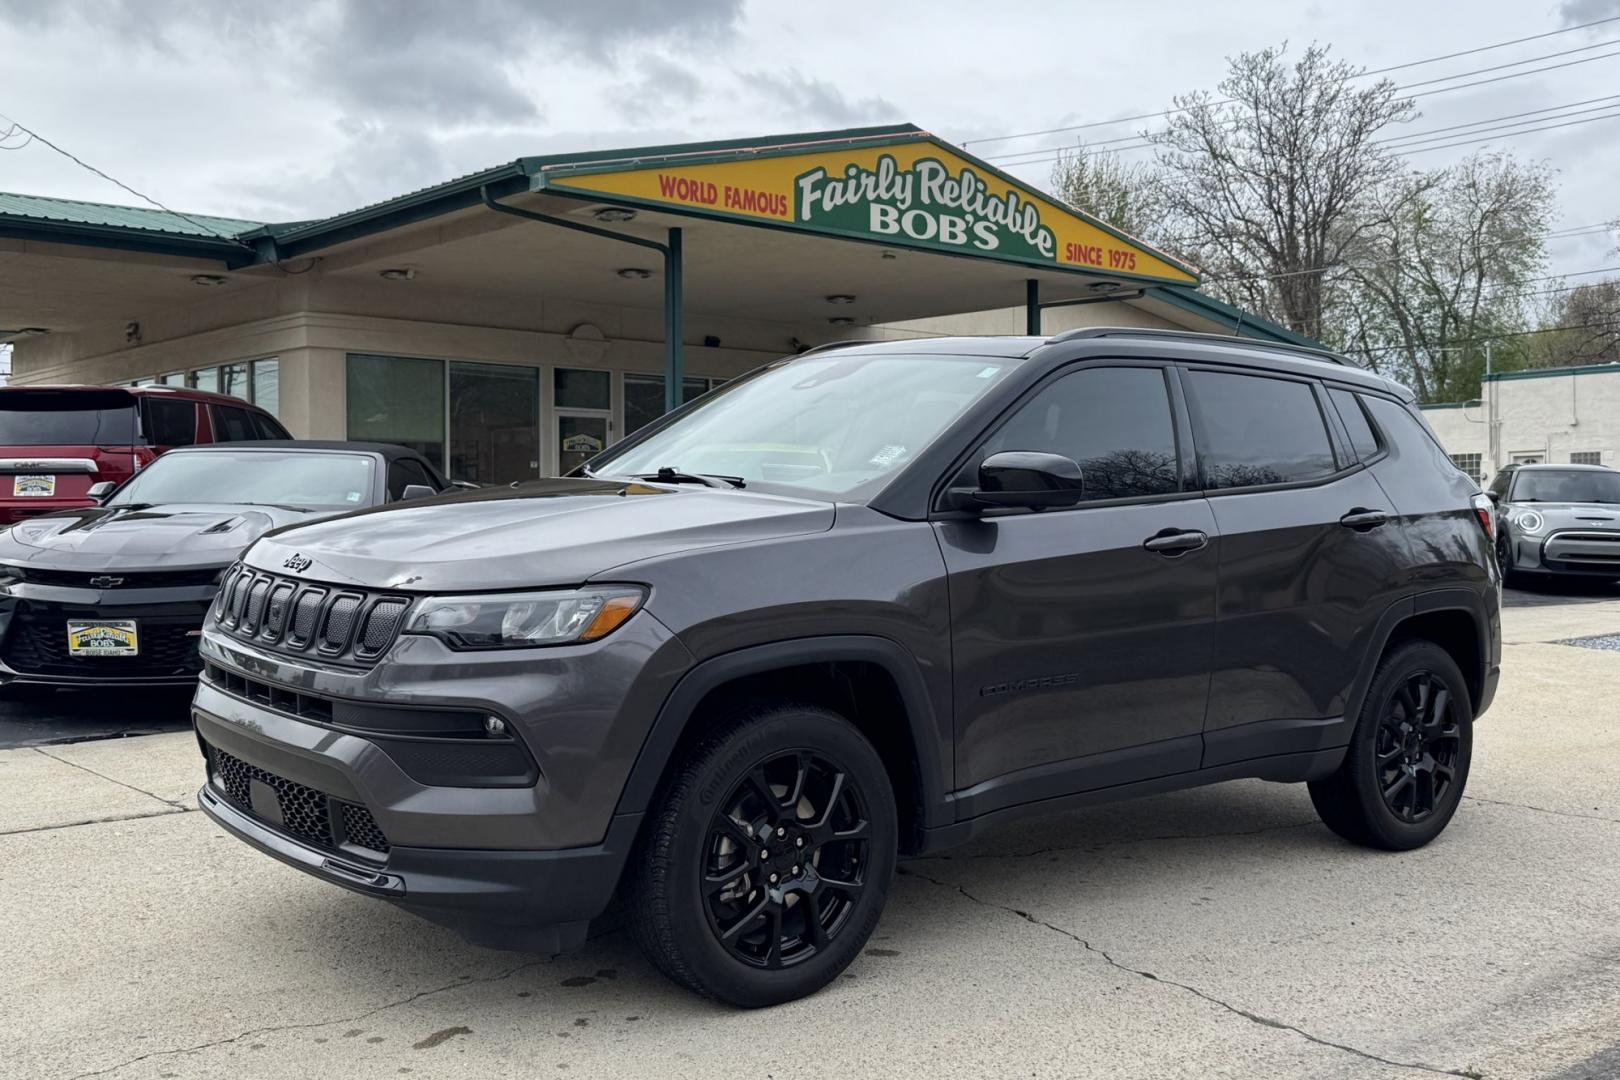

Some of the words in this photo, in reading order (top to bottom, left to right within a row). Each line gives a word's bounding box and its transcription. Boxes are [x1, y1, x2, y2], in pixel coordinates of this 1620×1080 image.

[658, 174, 718, 205] WORLD
[724, 186, 788, 217] FAMOUS
[799, 157, 914, 221] Fairly
[915, 161, 1055, 258] Reliable
[869, 203, 1000, 250] BOB'S
[1065, 242, 1103, 266] SINCE
[1108, 249, 1136, 271] 1975
[283, 553, 313, 573] Jeep
